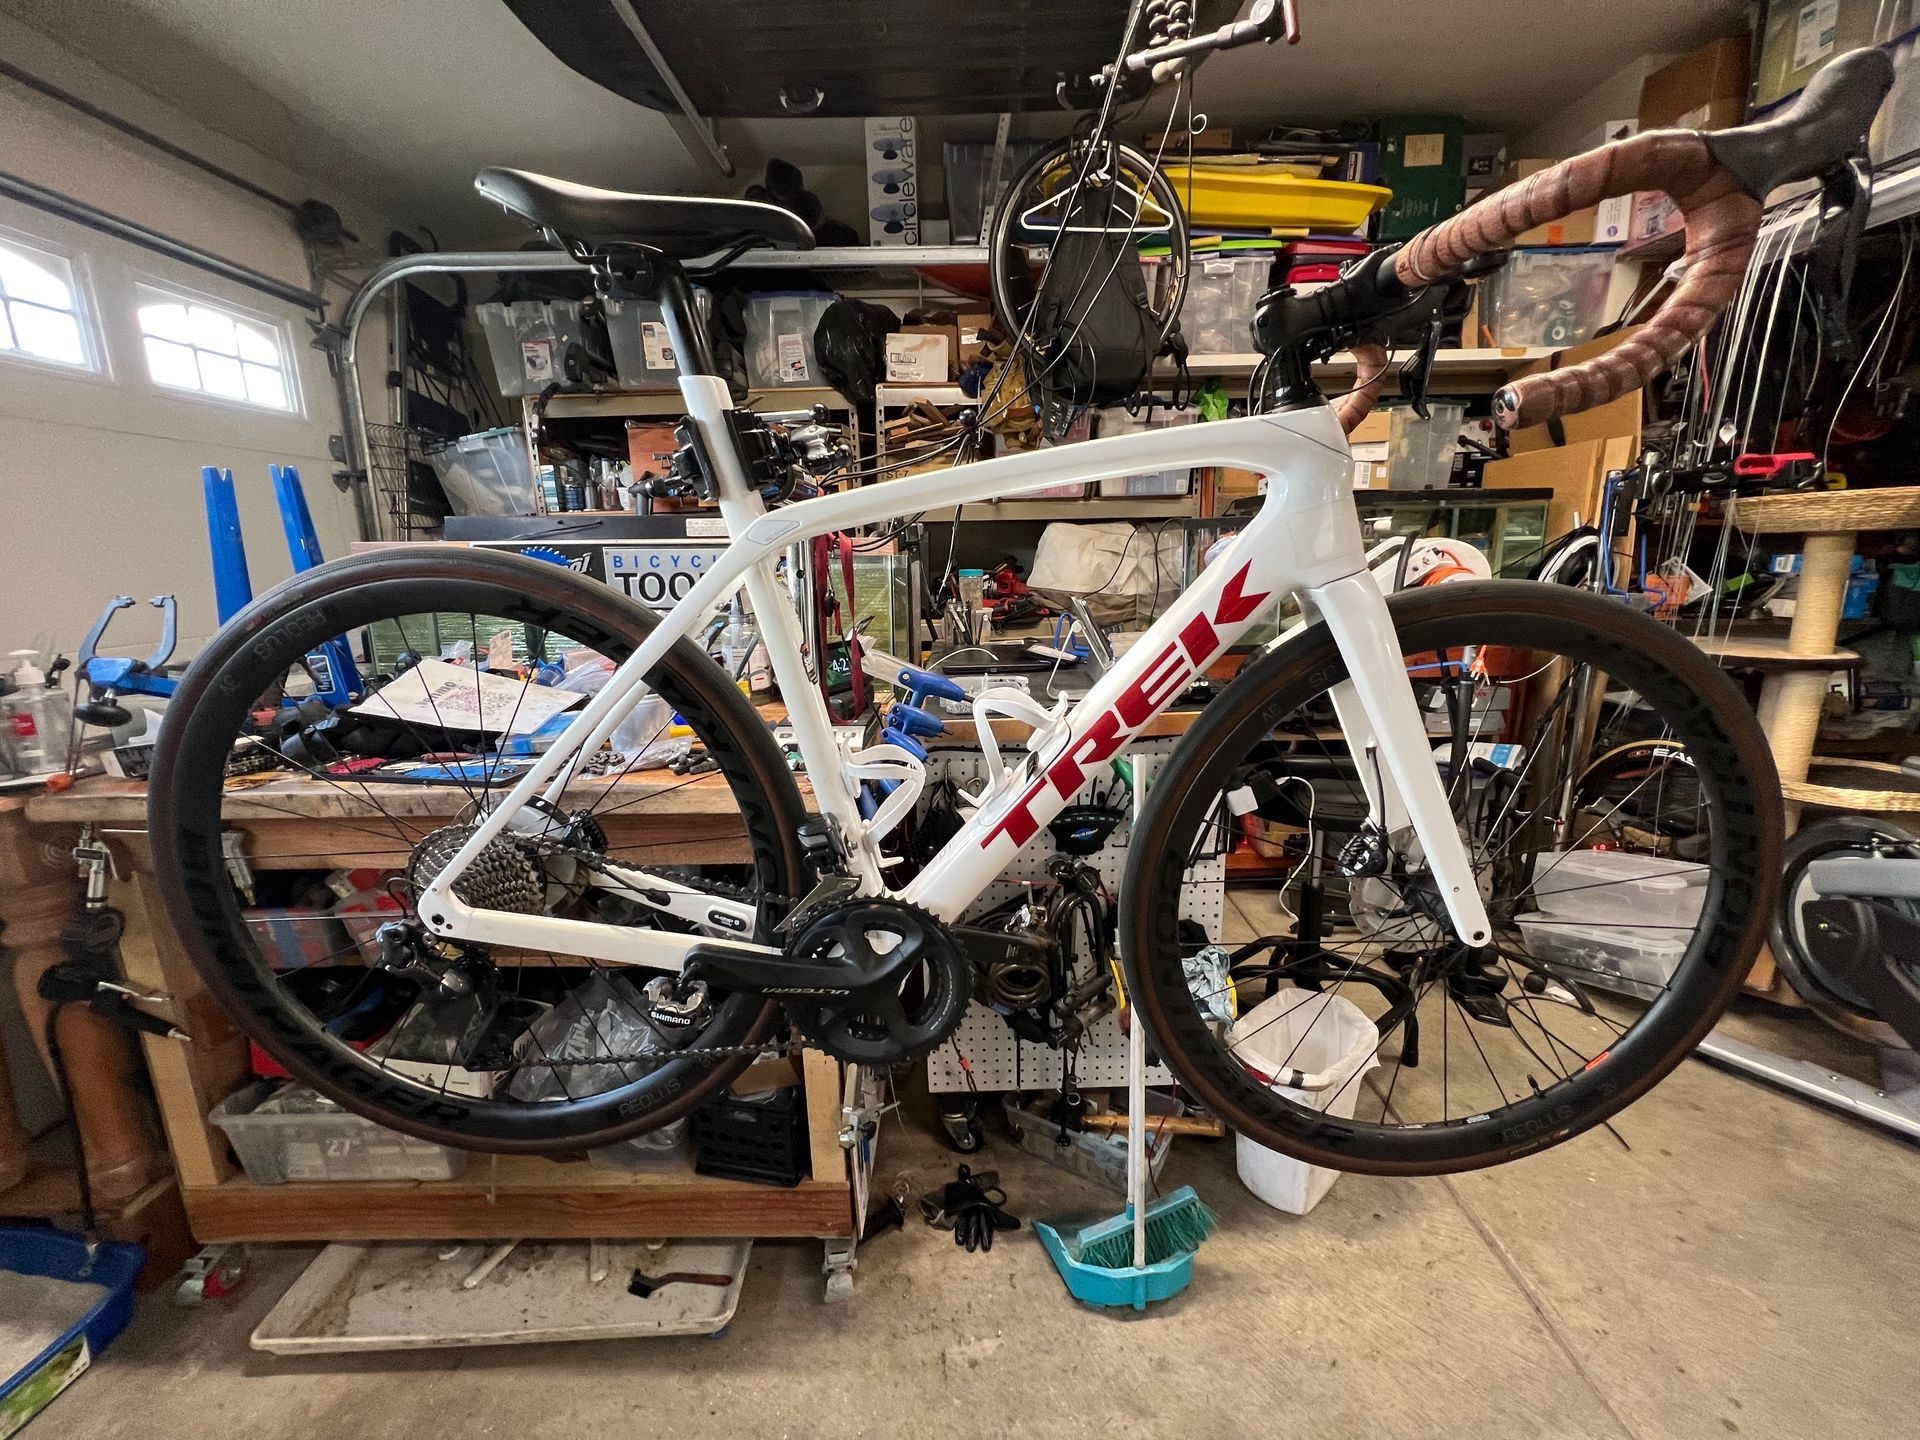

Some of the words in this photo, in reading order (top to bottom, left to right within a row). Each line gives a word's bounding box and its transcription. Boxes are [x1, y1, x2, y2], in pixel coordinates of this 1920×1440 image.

[899, 117, 917, 246] circleware
[614, 571, 706, 602] TOO
[253, 609, 327, 660] AEOLUS
[831, 657, 849, 673] 4:2
[980, 557, 1272, 849] TREK
[761, 987, 850, 995] ULTEGRA
[650, 1010, 691, 1025] SHIMANO
[619, 1078, 681, 1114] AEOLUS
